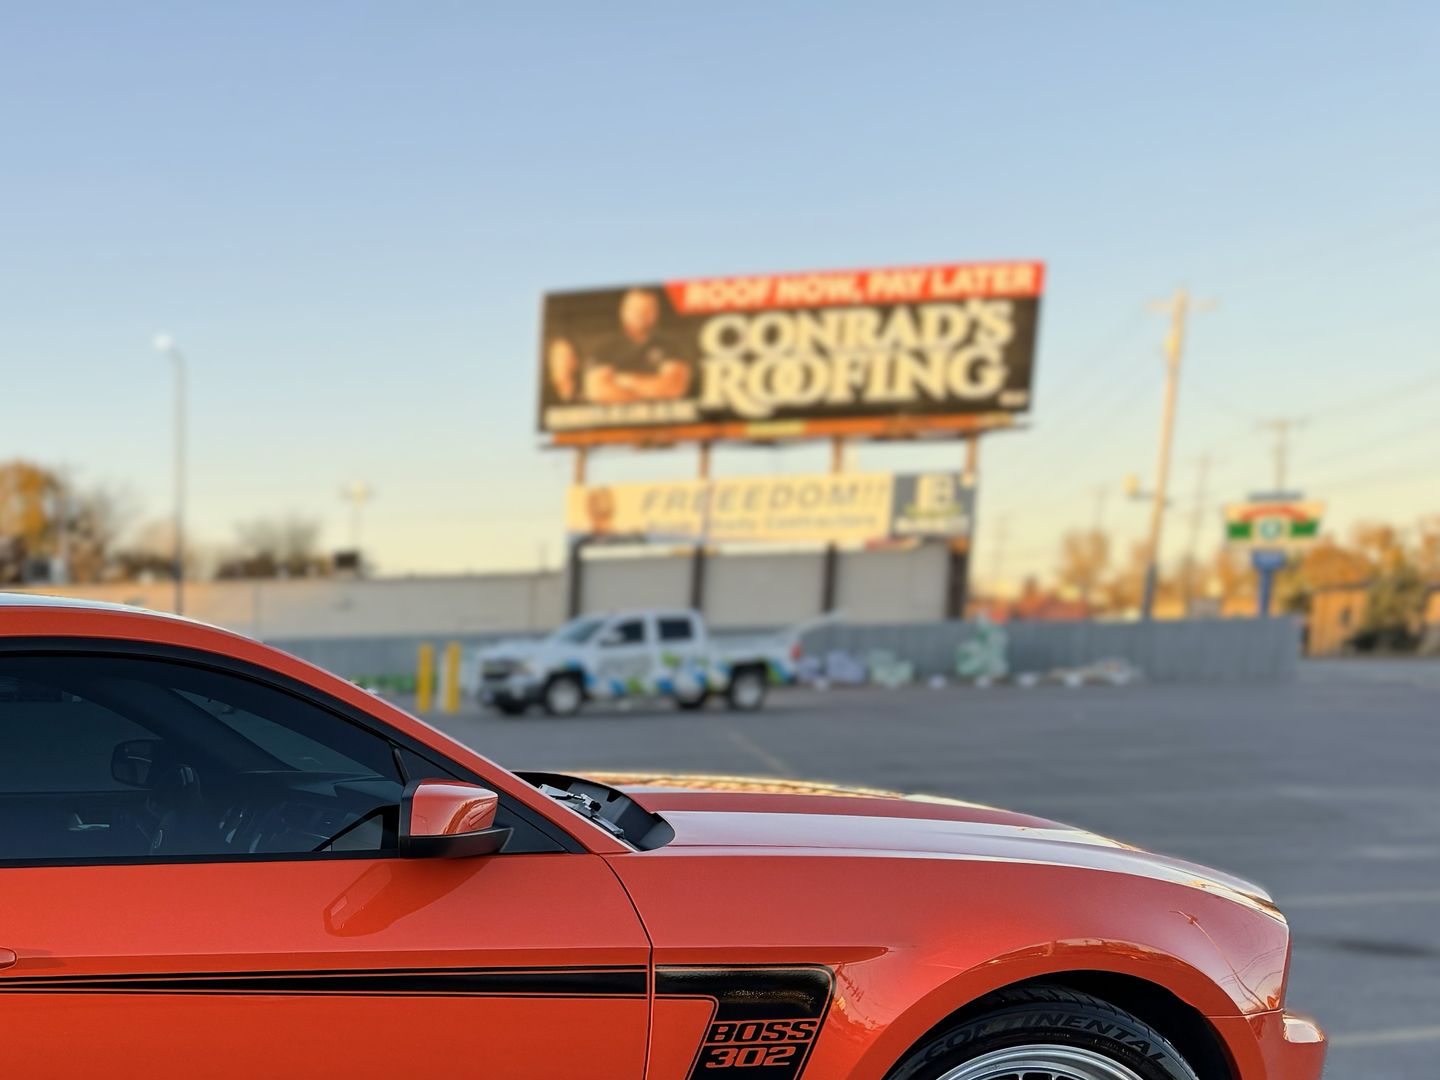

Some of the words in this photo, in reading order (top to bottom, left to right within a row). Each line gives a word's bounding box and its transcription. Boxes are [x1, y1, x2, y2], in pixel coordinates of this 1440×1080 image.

[684, 279, 774, 310] ROOF
[868, 268, 927, 299] PAY
[931, 263, 1035, 296] LATER
[699, 298, 1016, 356] CONRAD'S
[700, 346, 1008, 419] ROOFING
[705, 1020, 818, 1042] BOSS
[706, 1046, 796, 1068] 302
